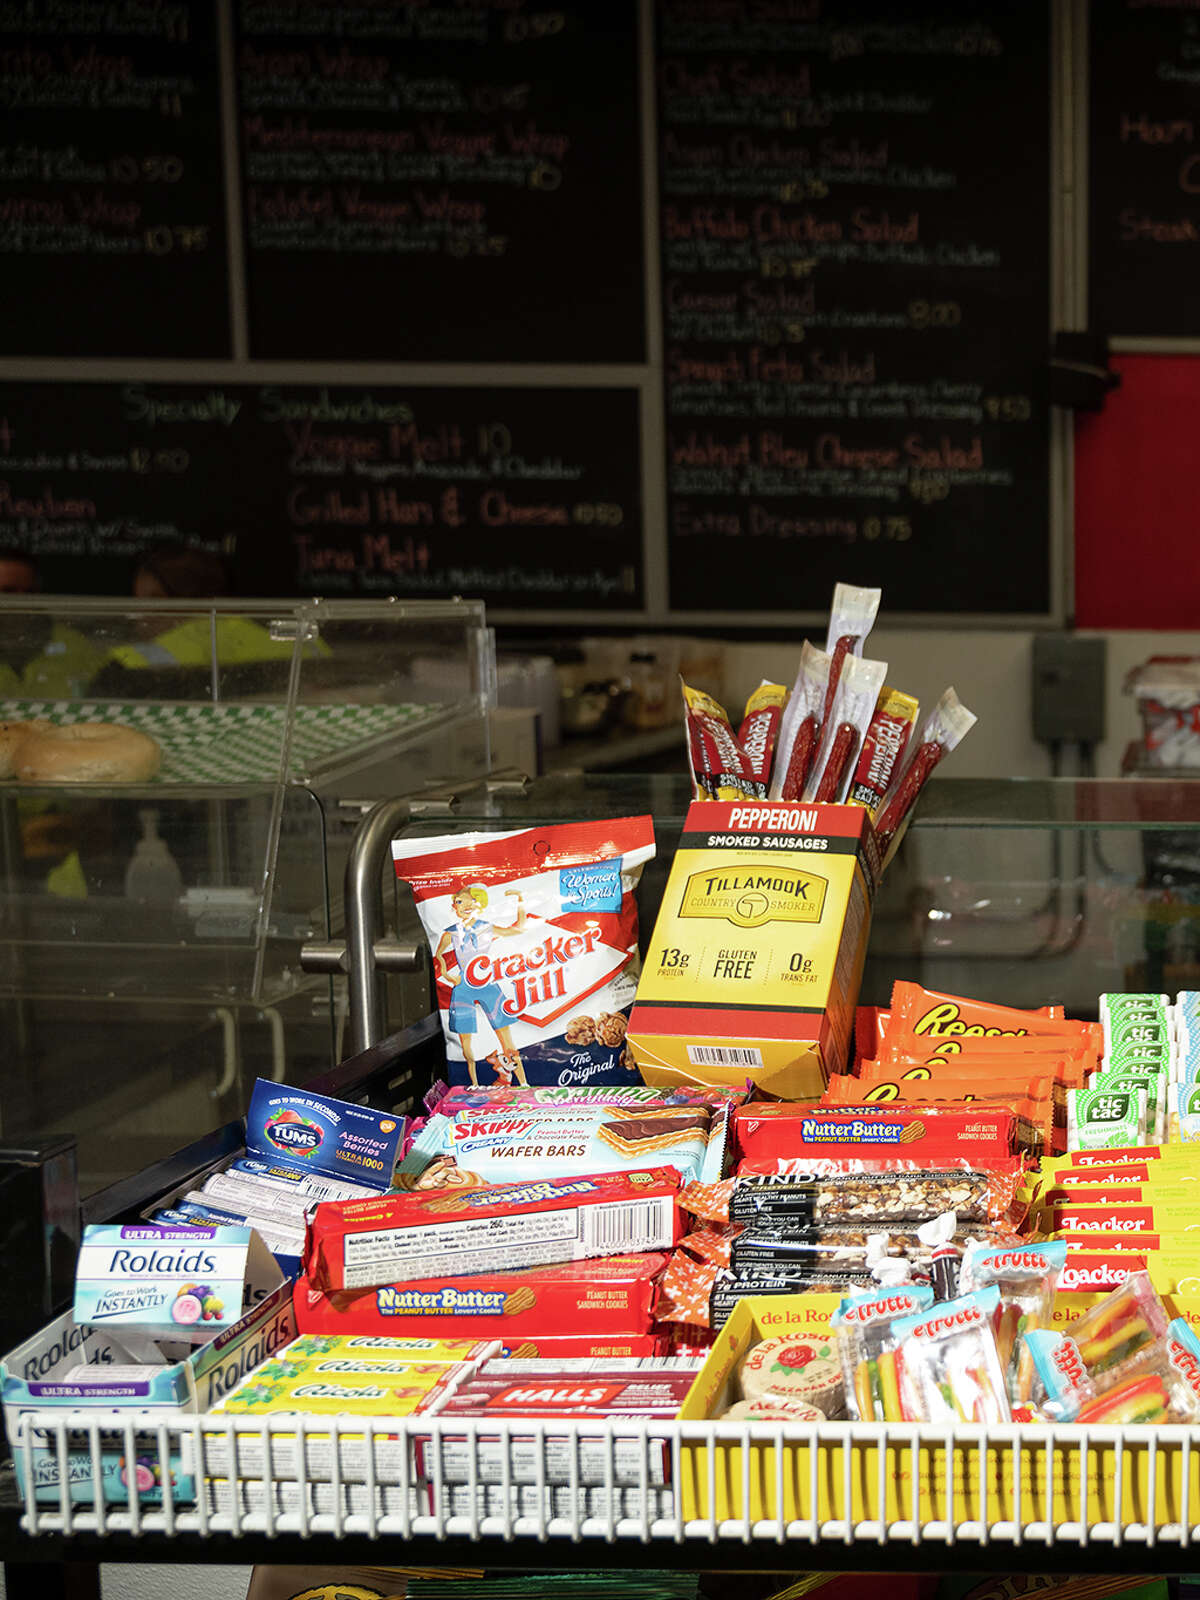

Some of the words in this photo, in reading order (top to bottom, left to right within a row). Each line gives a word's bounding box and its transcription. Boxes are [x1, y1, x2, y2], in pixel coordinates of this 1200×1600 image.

[1120, 114, 1193, 144] Ham
[848, 211, 918, 243] Salad
[904, 431, 983, 468] Salad
[728, 807, 819, 832] PEPPERONI
[708, 835, 762, 848] SMOKED
[763, 837, 829, 850] SAUSAGES
[562, 871, 618, 889] Women
[705, 876, 811, 900] TILLAMOOK
[690, 897, 737, 909] COUNTRY
[770, 901, 816, 912] SMOKER
[466, 926, 602, 987] Cracker
[660, 948, 691, 968] 13g
[718, 948, 757, 961] GLUTEN
[789, 952, 814, 973] 0g
[657, 968, 685, 978] PROTEIN
[780, 973, 803, 983] TRANS
[804, 974, 819, 983] FAT
[713, 960, 754, 979] FREE
[502, 967, 568, 1016] Jill
[571, 1052, 591, 1066] The
[558, 1055, 615, 1086] Original
[1098, 1096, 1123, 1109] tic
[1092, 1107, 1121, 1119] tac
[273, 1127, 317, 1147] TUMS
[454, 1120, 534, 1140] SKIPPY
[339, 1131, 389, 1151] Assorted
[343, 1141, 381, 1157] Berries
[491, 1145, 542, 1158] WAFER
[547, 1144, 586, 1157] BARS
[362, 1157, 384, 1171] 1000
[125, 1230, 162, 1240] ULTRA
[164, 1231, 211, 1240] STRENGTH
[109, 1249, 217, 1272] Rolaids
[95, 1293, 168, 1312] INSTANTLY
[377, 1288, 441, 1307] Nutter
[442, 1290, 506, 1307] Butter
[291, 1385, 386, 1402] Ricola
[502, 1386, 608, 1404] HALLS
